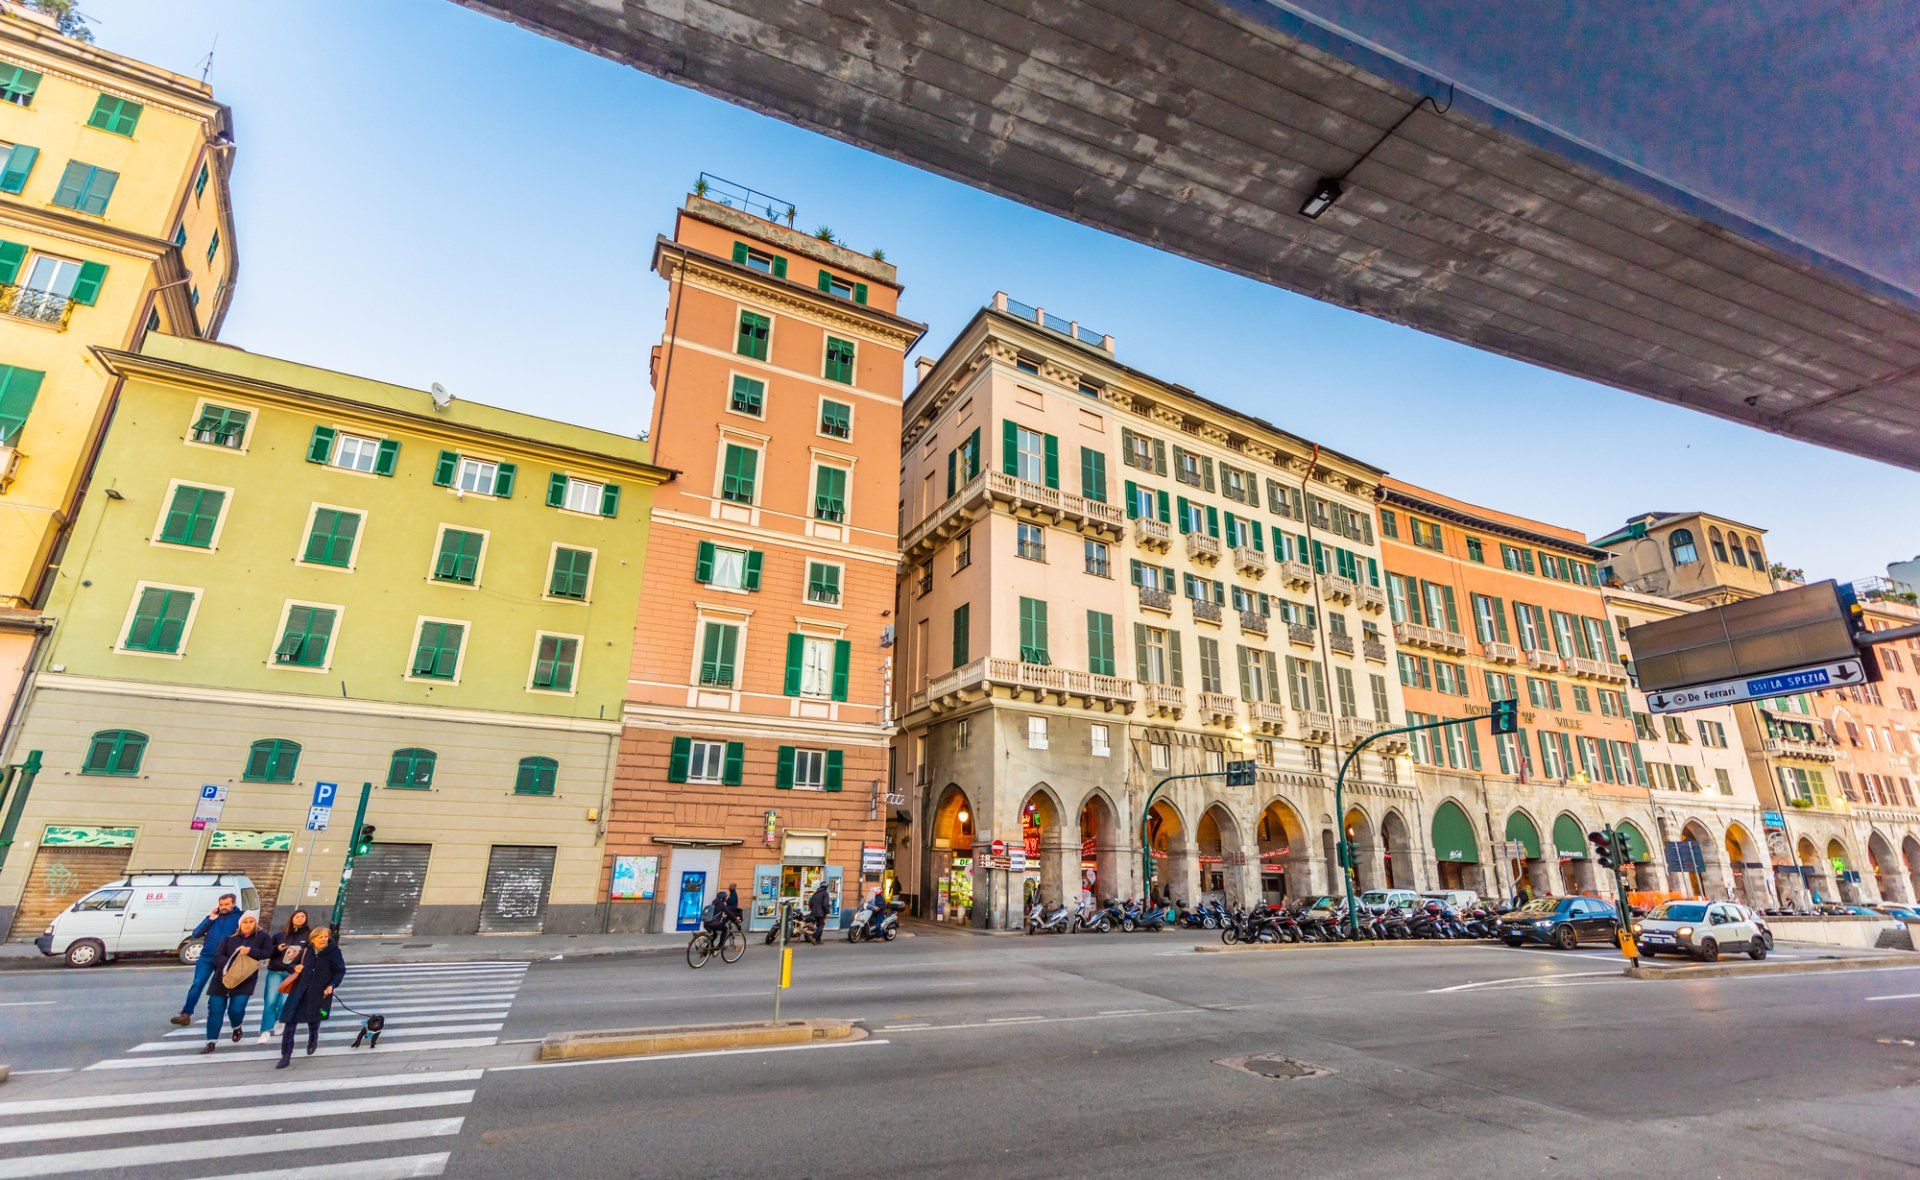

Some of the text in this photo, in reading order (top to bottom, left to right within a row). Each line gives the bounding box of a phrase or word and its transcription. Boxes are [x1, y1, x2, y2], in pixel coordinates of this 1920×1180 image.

[1770, 680, 1783, 689] LA
[1787, 672, 1826, 687] SPEZIA
[1687, 686, 1736, 702] De Ferrari
[1463, 703, 1491, 716] HOTE
[1554, 716, 1583, 729] VILLE
[205, 786, 214, 797] P
[317, 784, 333, 803] P
